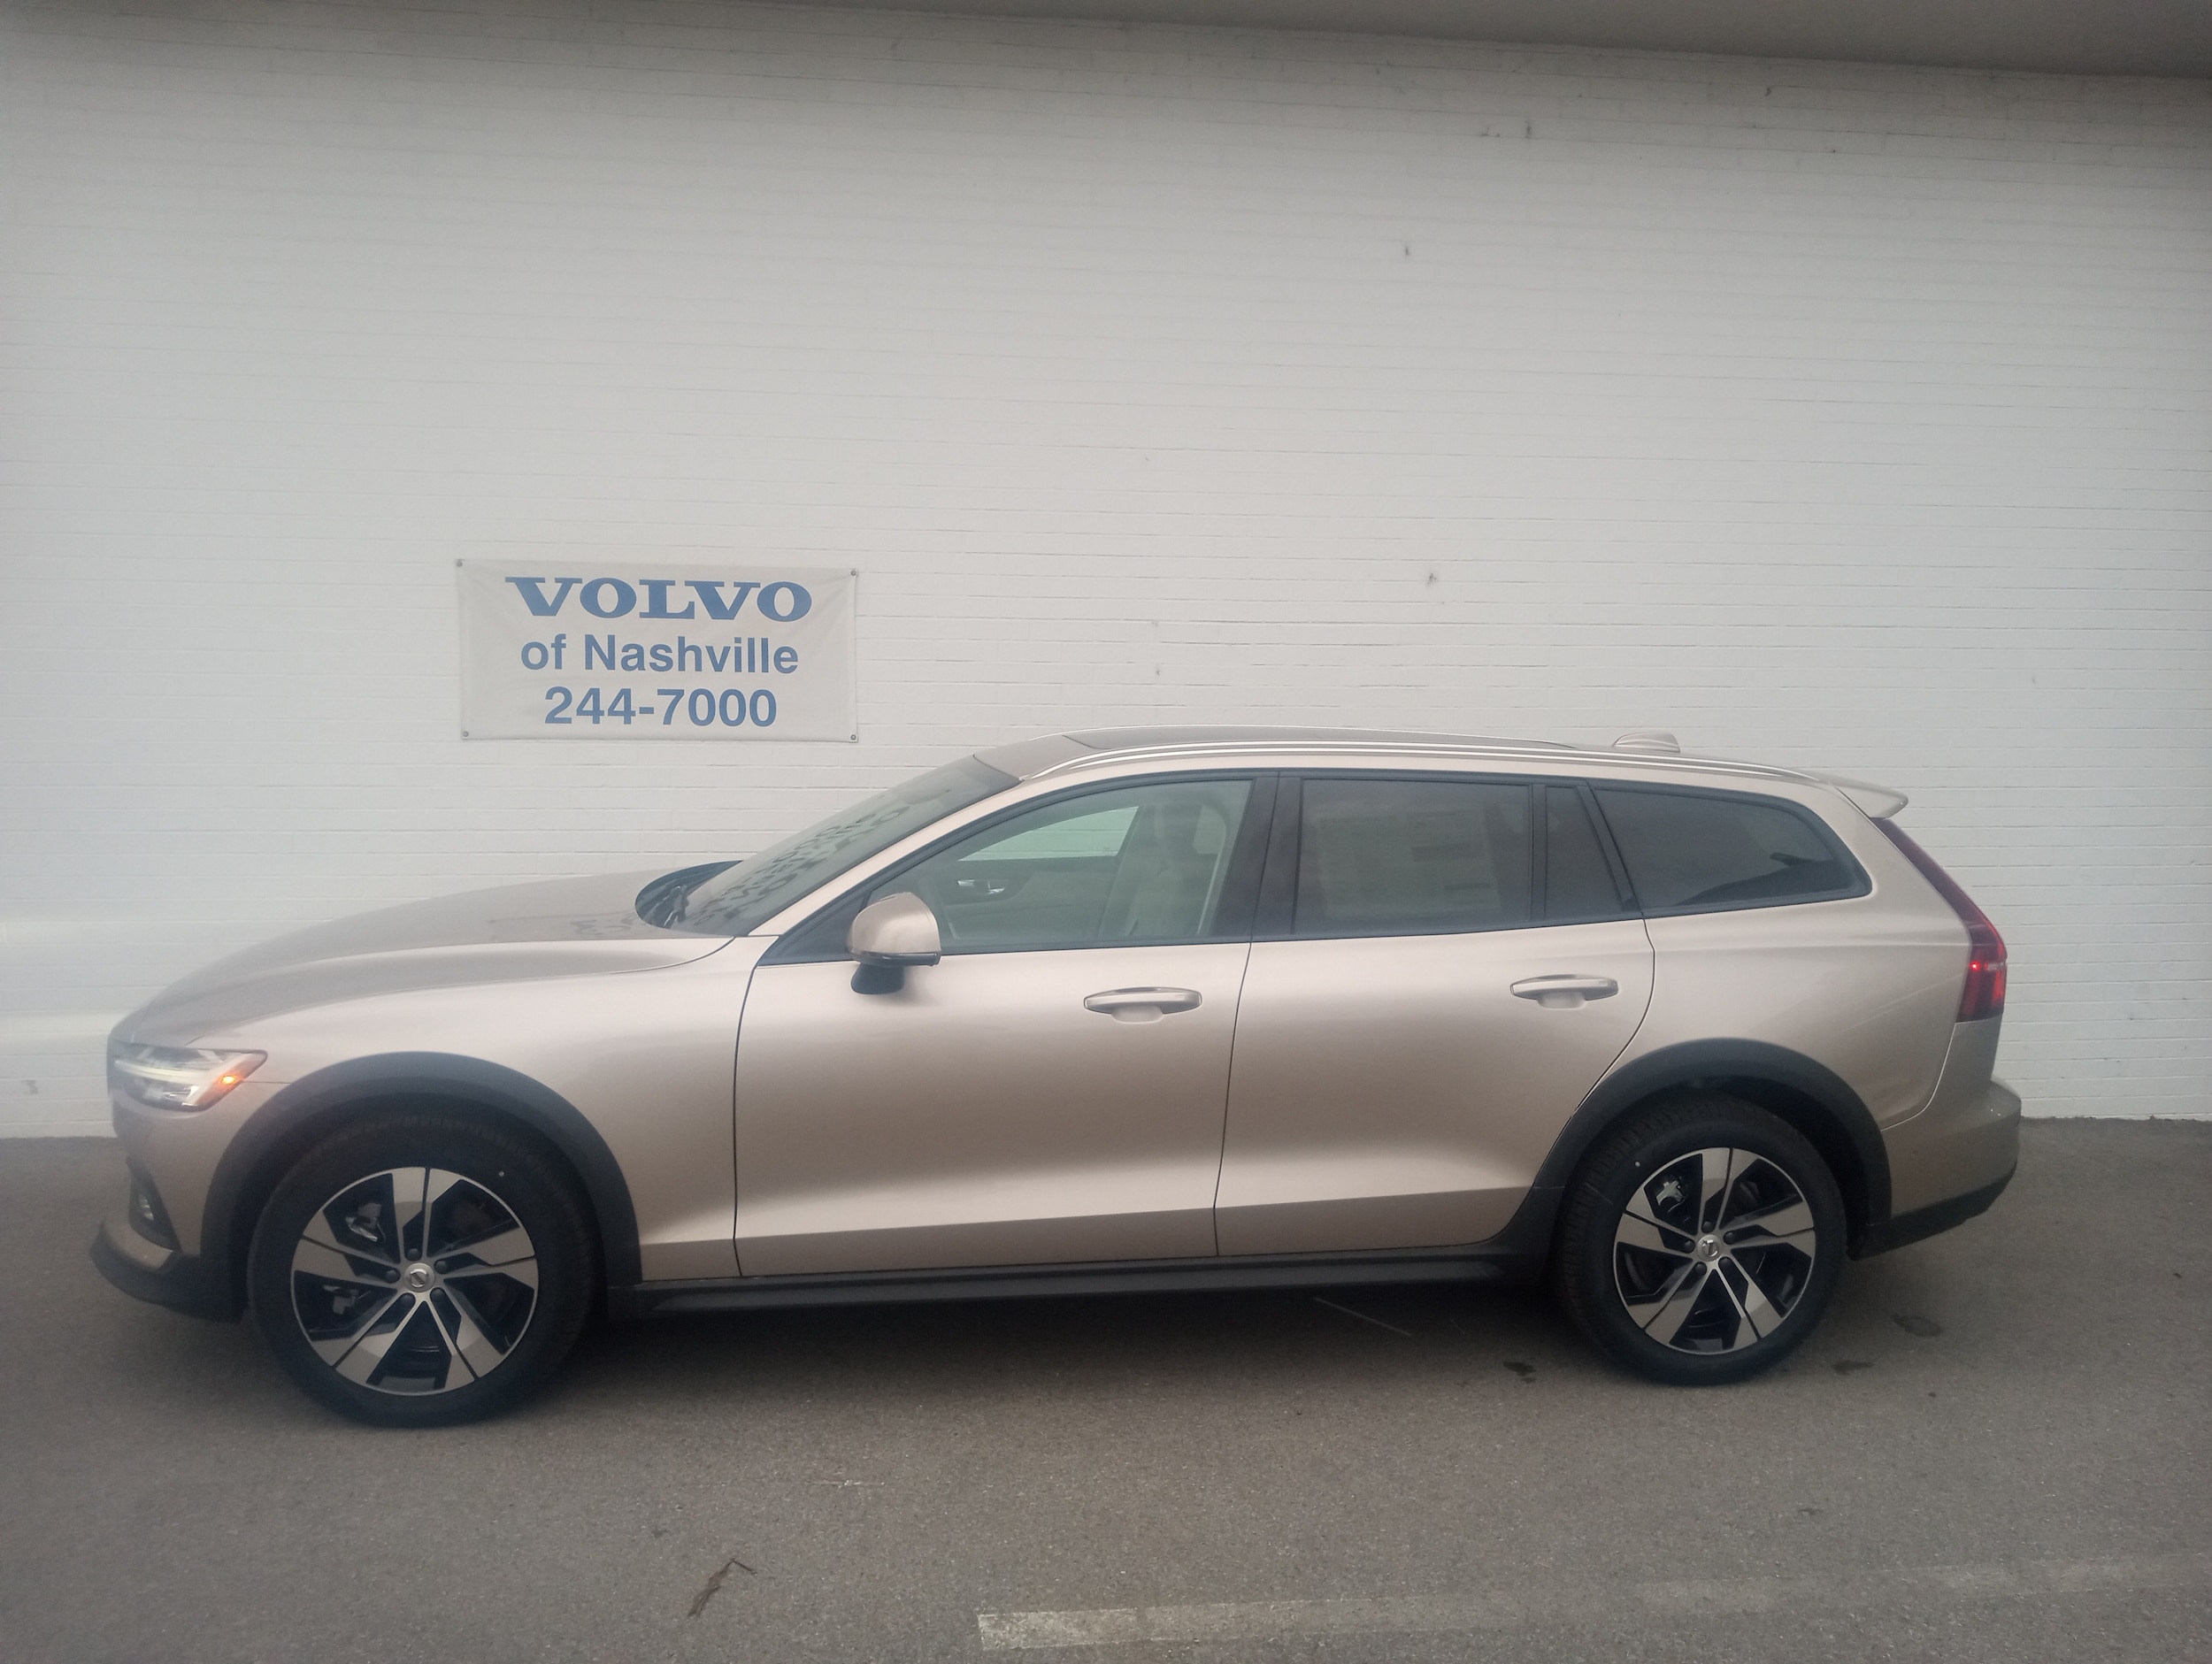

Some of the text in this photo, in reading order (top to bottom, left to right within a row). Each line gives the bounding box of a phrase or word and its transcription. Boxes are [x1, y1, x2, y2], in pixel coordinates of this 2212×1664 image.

[505, 576, 812, 622] VOLVO
[521, 633, 798, 673] of Nashville
[544, 686, 777, 726] 244-7000
